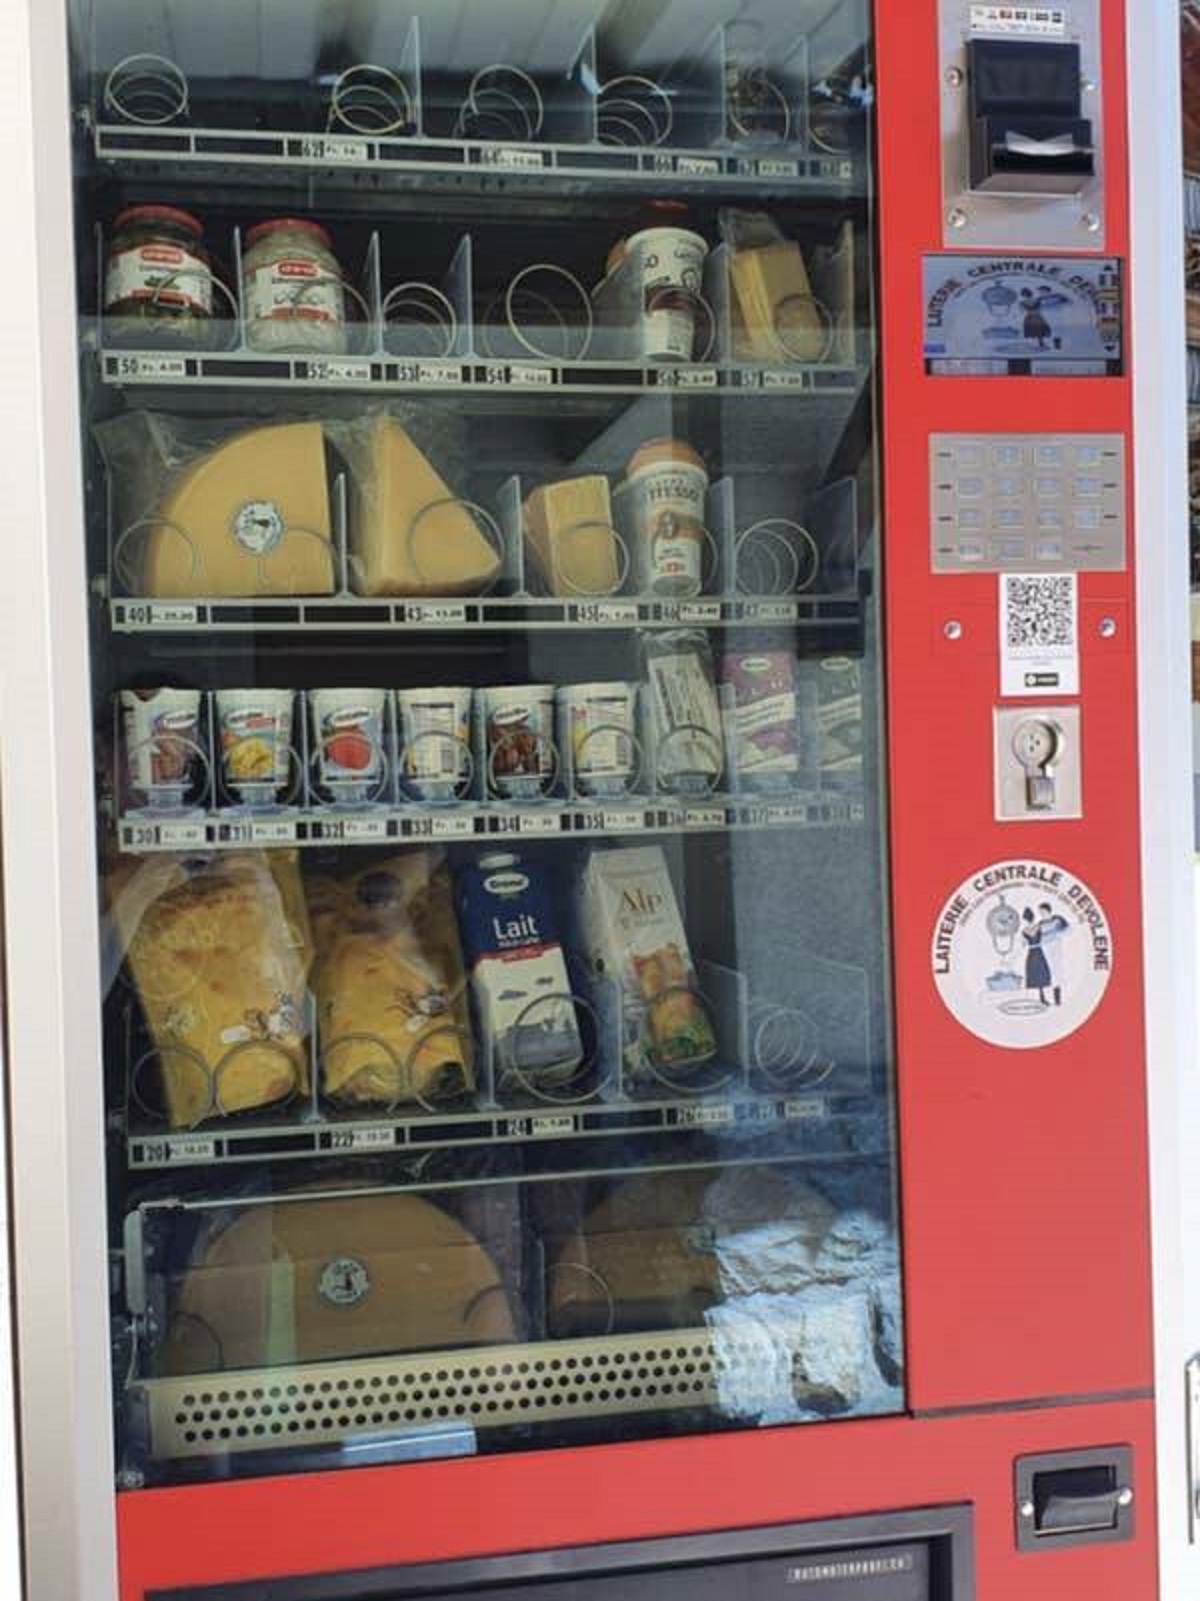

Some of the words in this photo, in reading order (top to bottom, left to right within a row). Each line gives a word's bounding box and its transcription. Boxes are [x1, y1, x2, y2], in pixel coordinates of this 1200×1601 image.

[623, 888, 663, 915] Alp
[493, 914, 539, 940] Lait
[935, 895, 969, 974] LAITERIE
[973, 864, 1064, 893] CENTRALE
